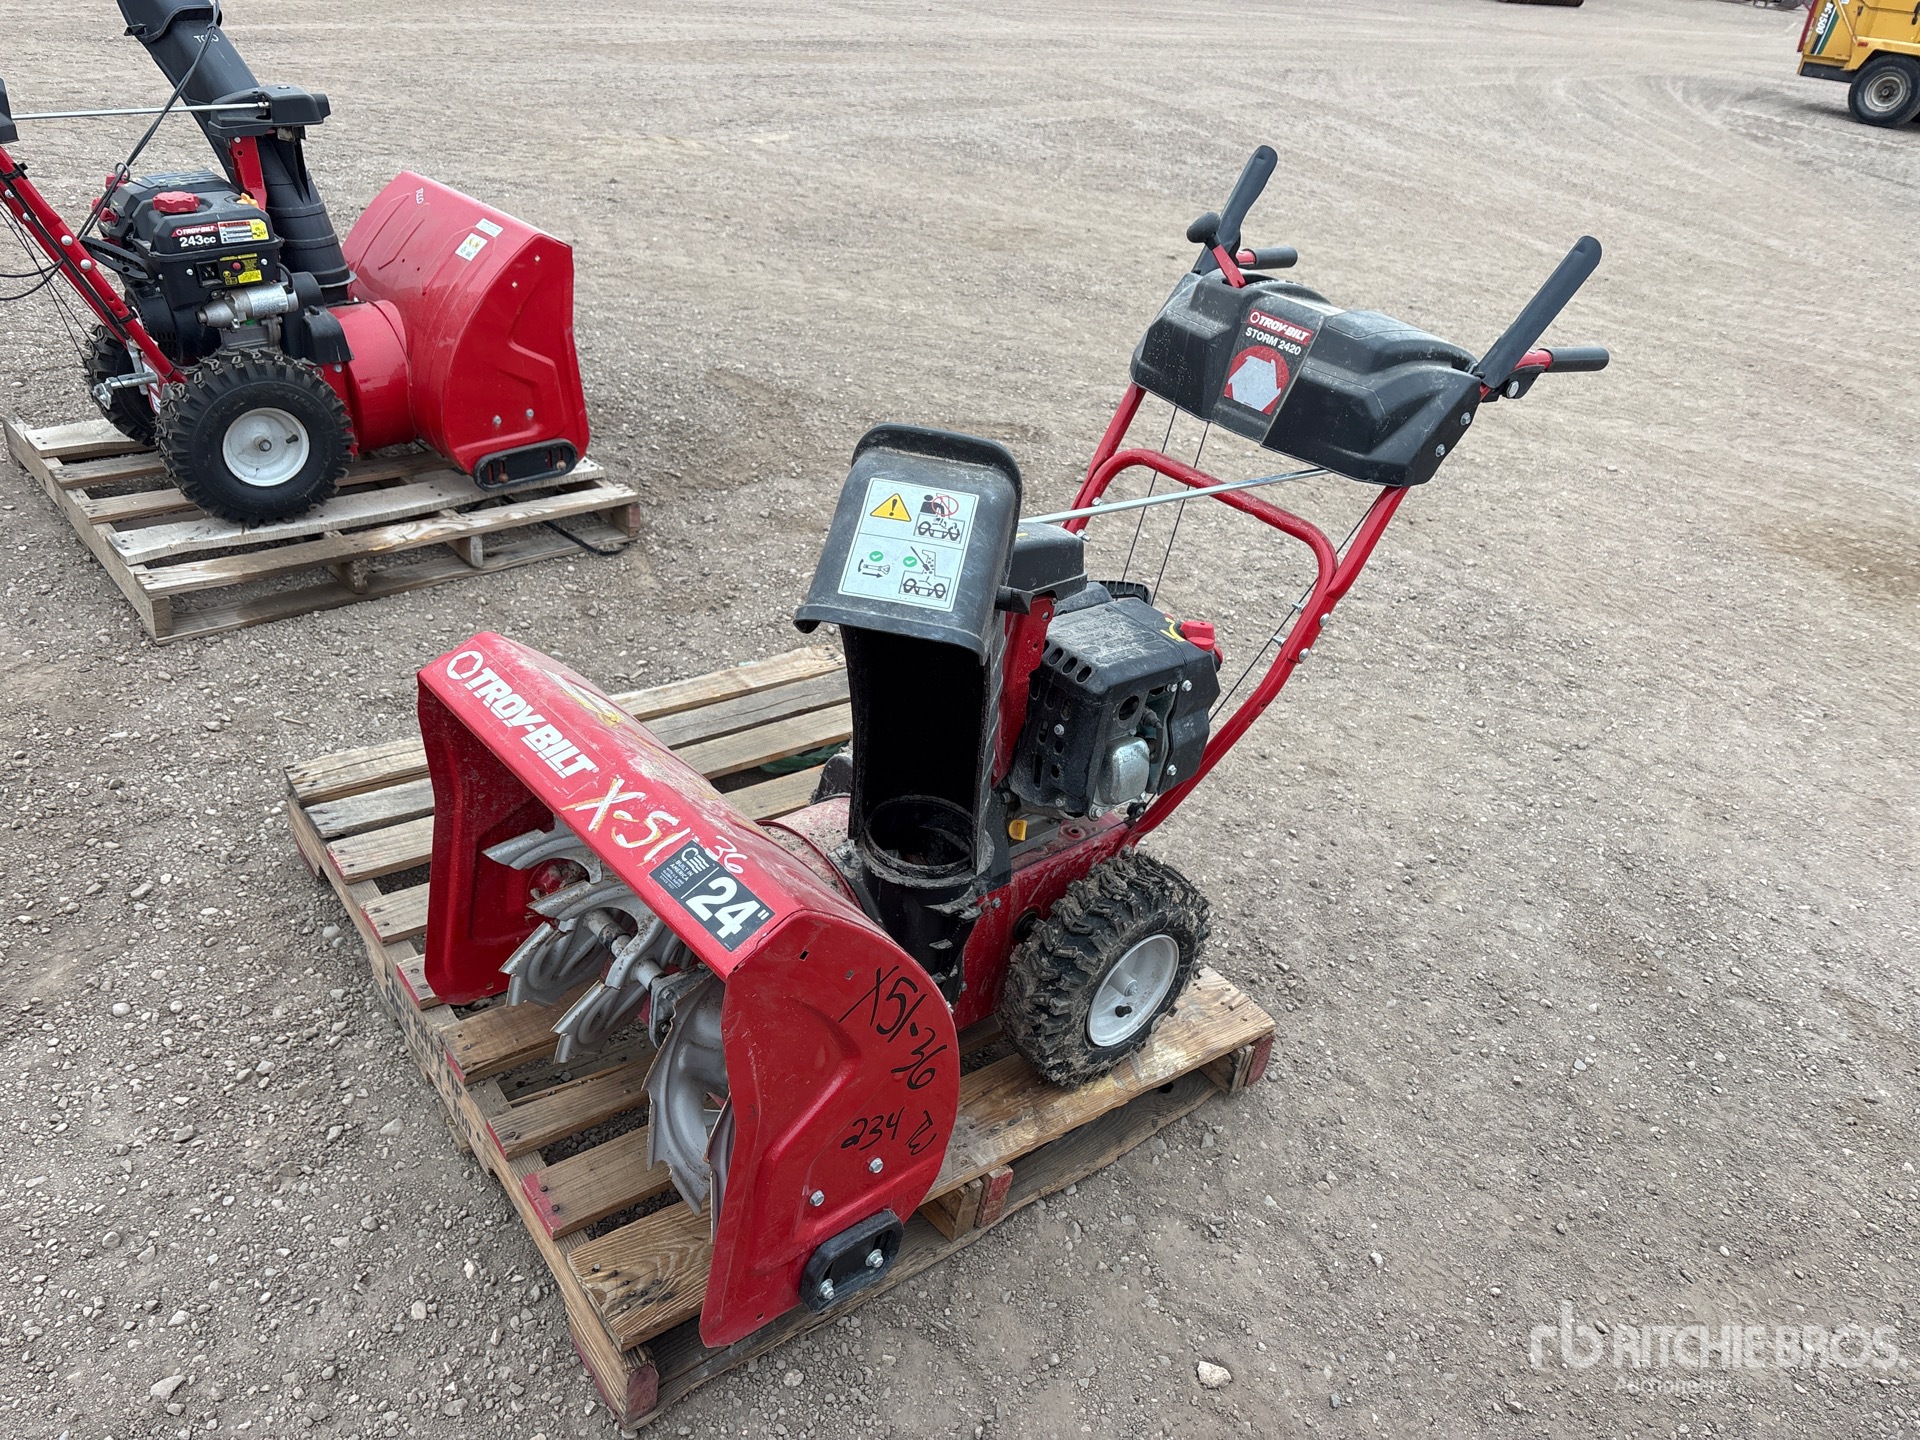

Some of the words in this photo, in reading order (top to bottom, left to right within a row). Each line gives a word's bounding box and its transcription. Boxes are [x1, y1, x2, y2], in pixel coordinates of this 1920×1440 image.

[179, 234, 217, 248] 243cc
[182, 225, 217, 236] TROY-BILT
[1258, 315, 1311, 342] TROY-BILT
[1245, 326, 1279, 347] STORM
[1278, 340, 1302, 355] 2420
[463, 666, 596, 779] TROY-BILT
[670, 863, 690, 882] AMERICA
[675, 859, 689, 872] BUILT
[840, 1106, 905, 1151] 234
